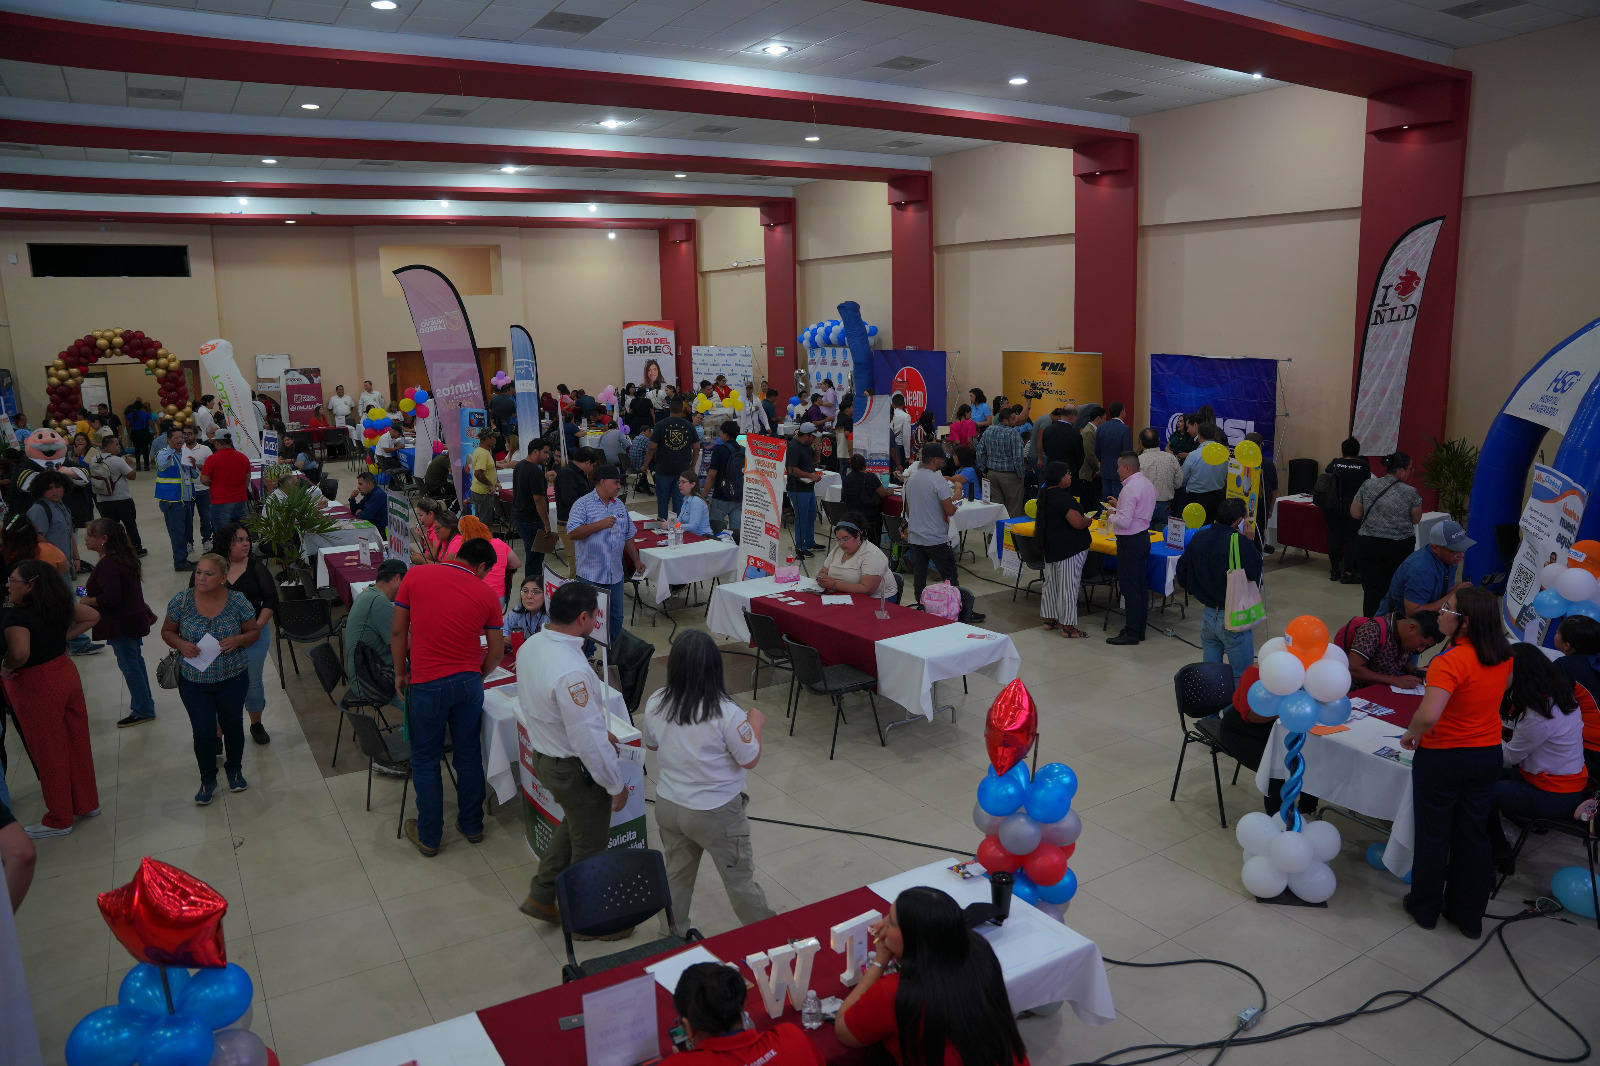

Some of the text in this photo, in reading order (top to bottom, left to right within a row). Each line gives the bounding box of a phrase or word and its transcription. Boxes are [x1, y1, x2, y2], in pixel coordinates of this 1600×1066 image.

[1377, 285, 1393, 307] I
[1371, 303, 1417, 325] NLD
[626, 337, 671, 345] FERIA DEL
[1041, 361, 1067, 372] TNL
